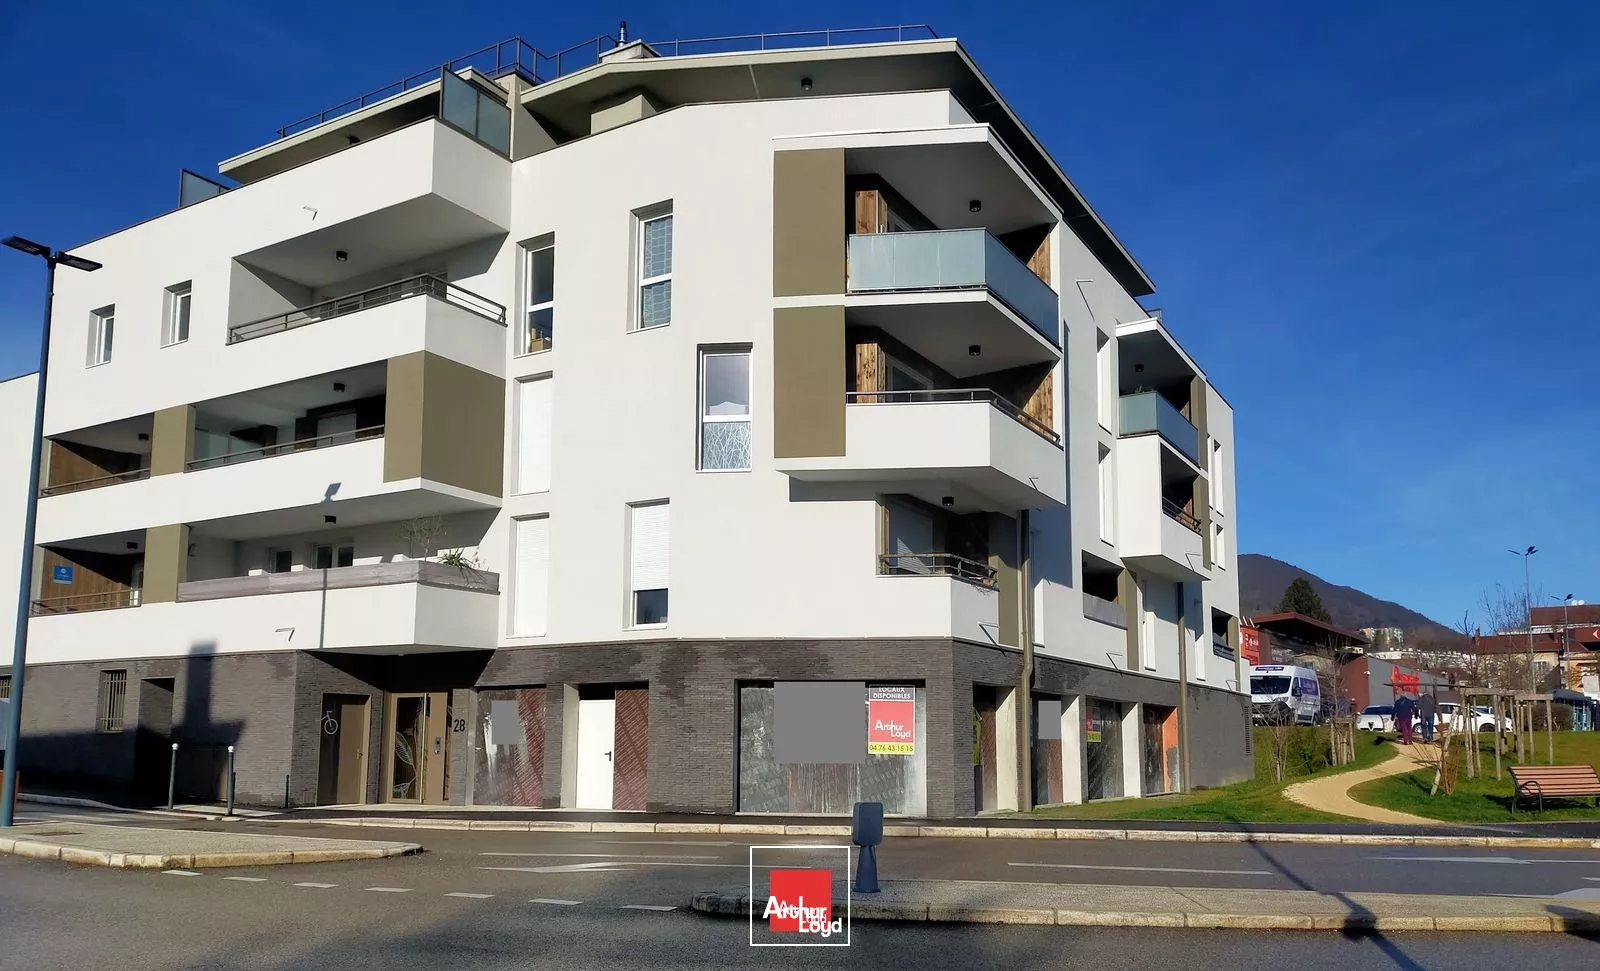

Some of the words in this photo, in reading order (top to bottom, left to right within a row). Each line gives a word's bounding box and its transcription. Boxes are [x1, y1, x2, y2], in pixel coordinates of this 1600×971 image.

[453, 719, 466, 732] 28
[875, 720, 904, 731] Arthur
[891, 730, 911, 740] Loyd
